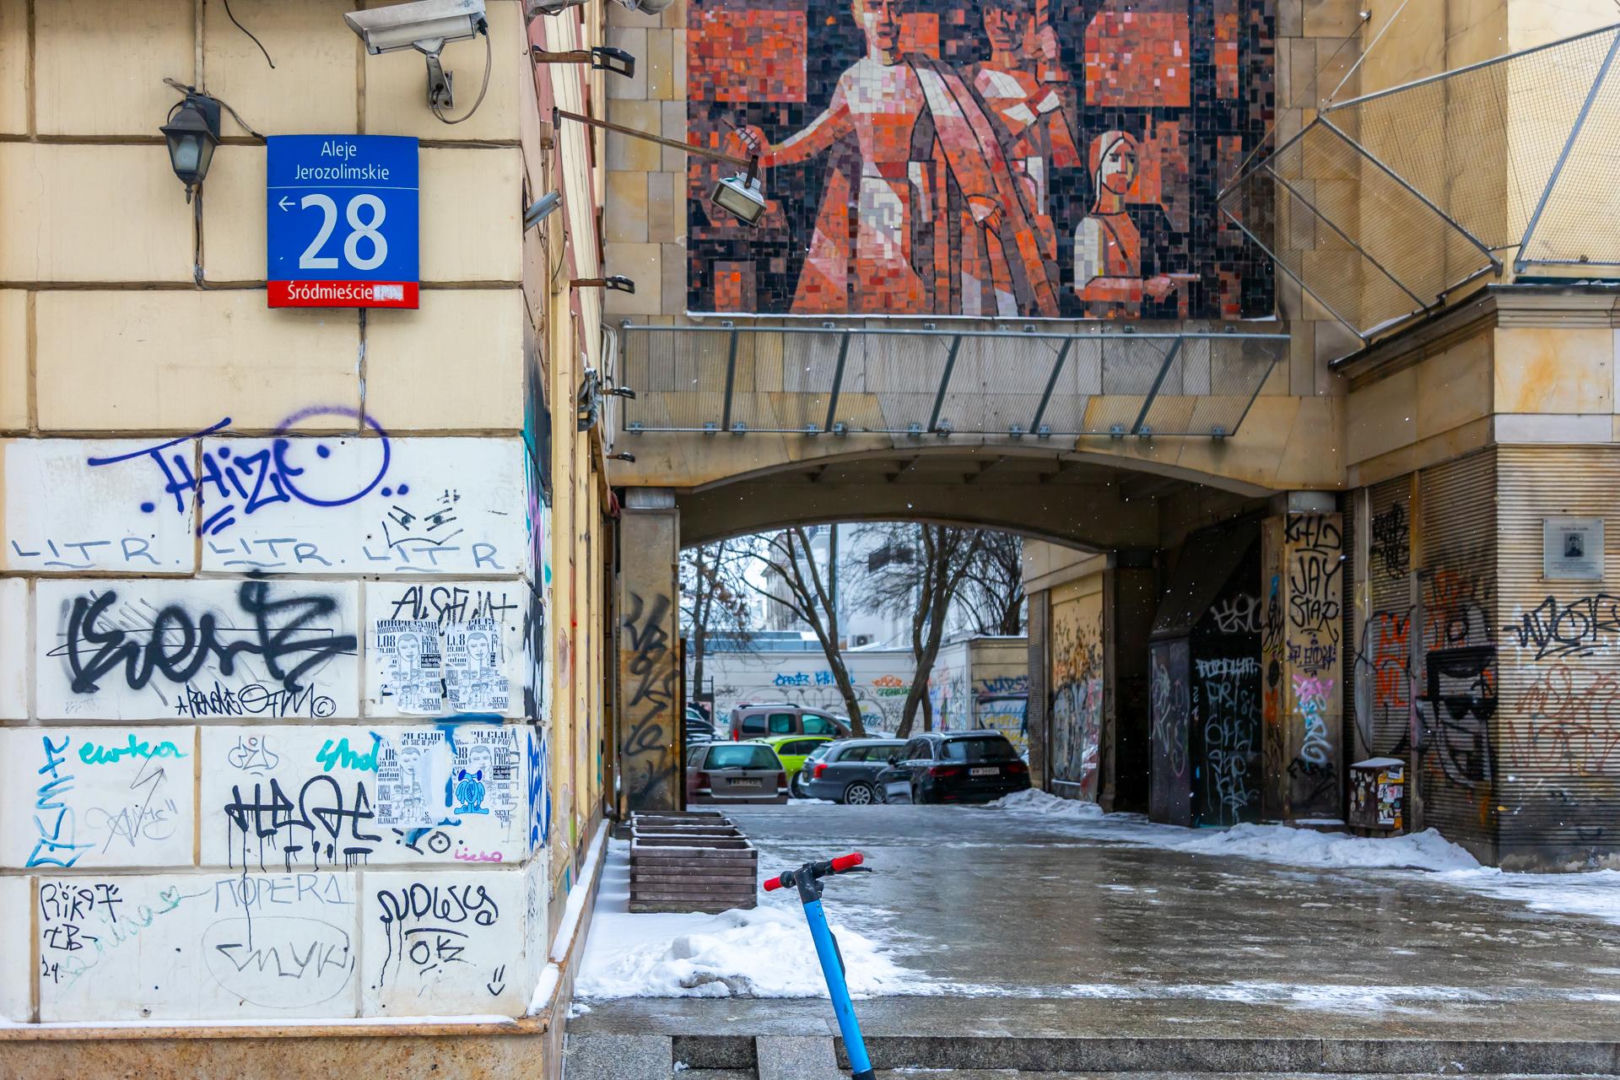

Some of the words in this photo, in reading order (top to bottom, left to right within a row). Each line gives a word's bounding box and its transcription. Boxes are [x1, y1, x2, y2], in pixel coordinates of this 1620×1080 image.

[321, 141, 357, 160] Aleje
[295, 164, 390, 180] Jerozolimskie
[299, 193, 388, 271] 28
[287, 281, 373, 300] Śródmieście
